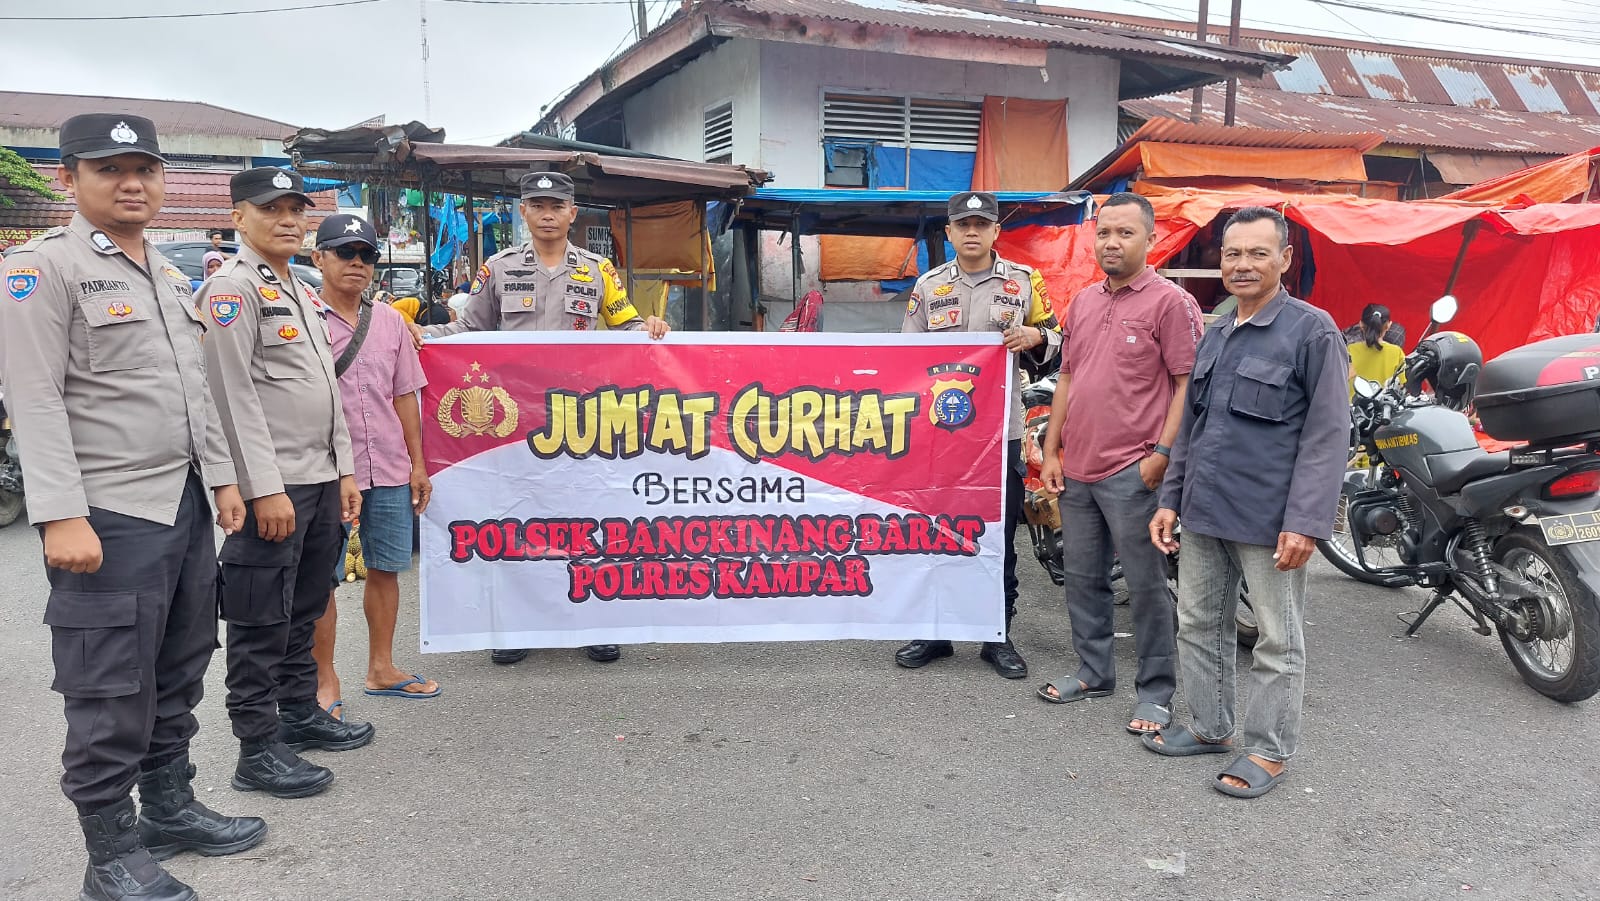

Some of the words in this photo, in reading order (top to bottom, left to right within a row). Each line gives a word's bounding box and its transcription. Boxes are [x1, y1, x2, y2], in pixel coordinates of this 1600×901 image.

[80, 280, 130, 294] PADRIANTO
[566, 285, 597, 297] POLRI
[932, 364, 976, 375] RIAU
[528, 385, 718, 460] JUM'AT
[732, 383, 919, 462] CURHAT
[449, 518, 598, 562] POLSEK
[600, 516, 854, 560] BANGKINANG
[856, 514, 985, 556] BARAT
[568, 559, 713, 602] POLRES
[714, 556, 873, 598] KAMPAR
